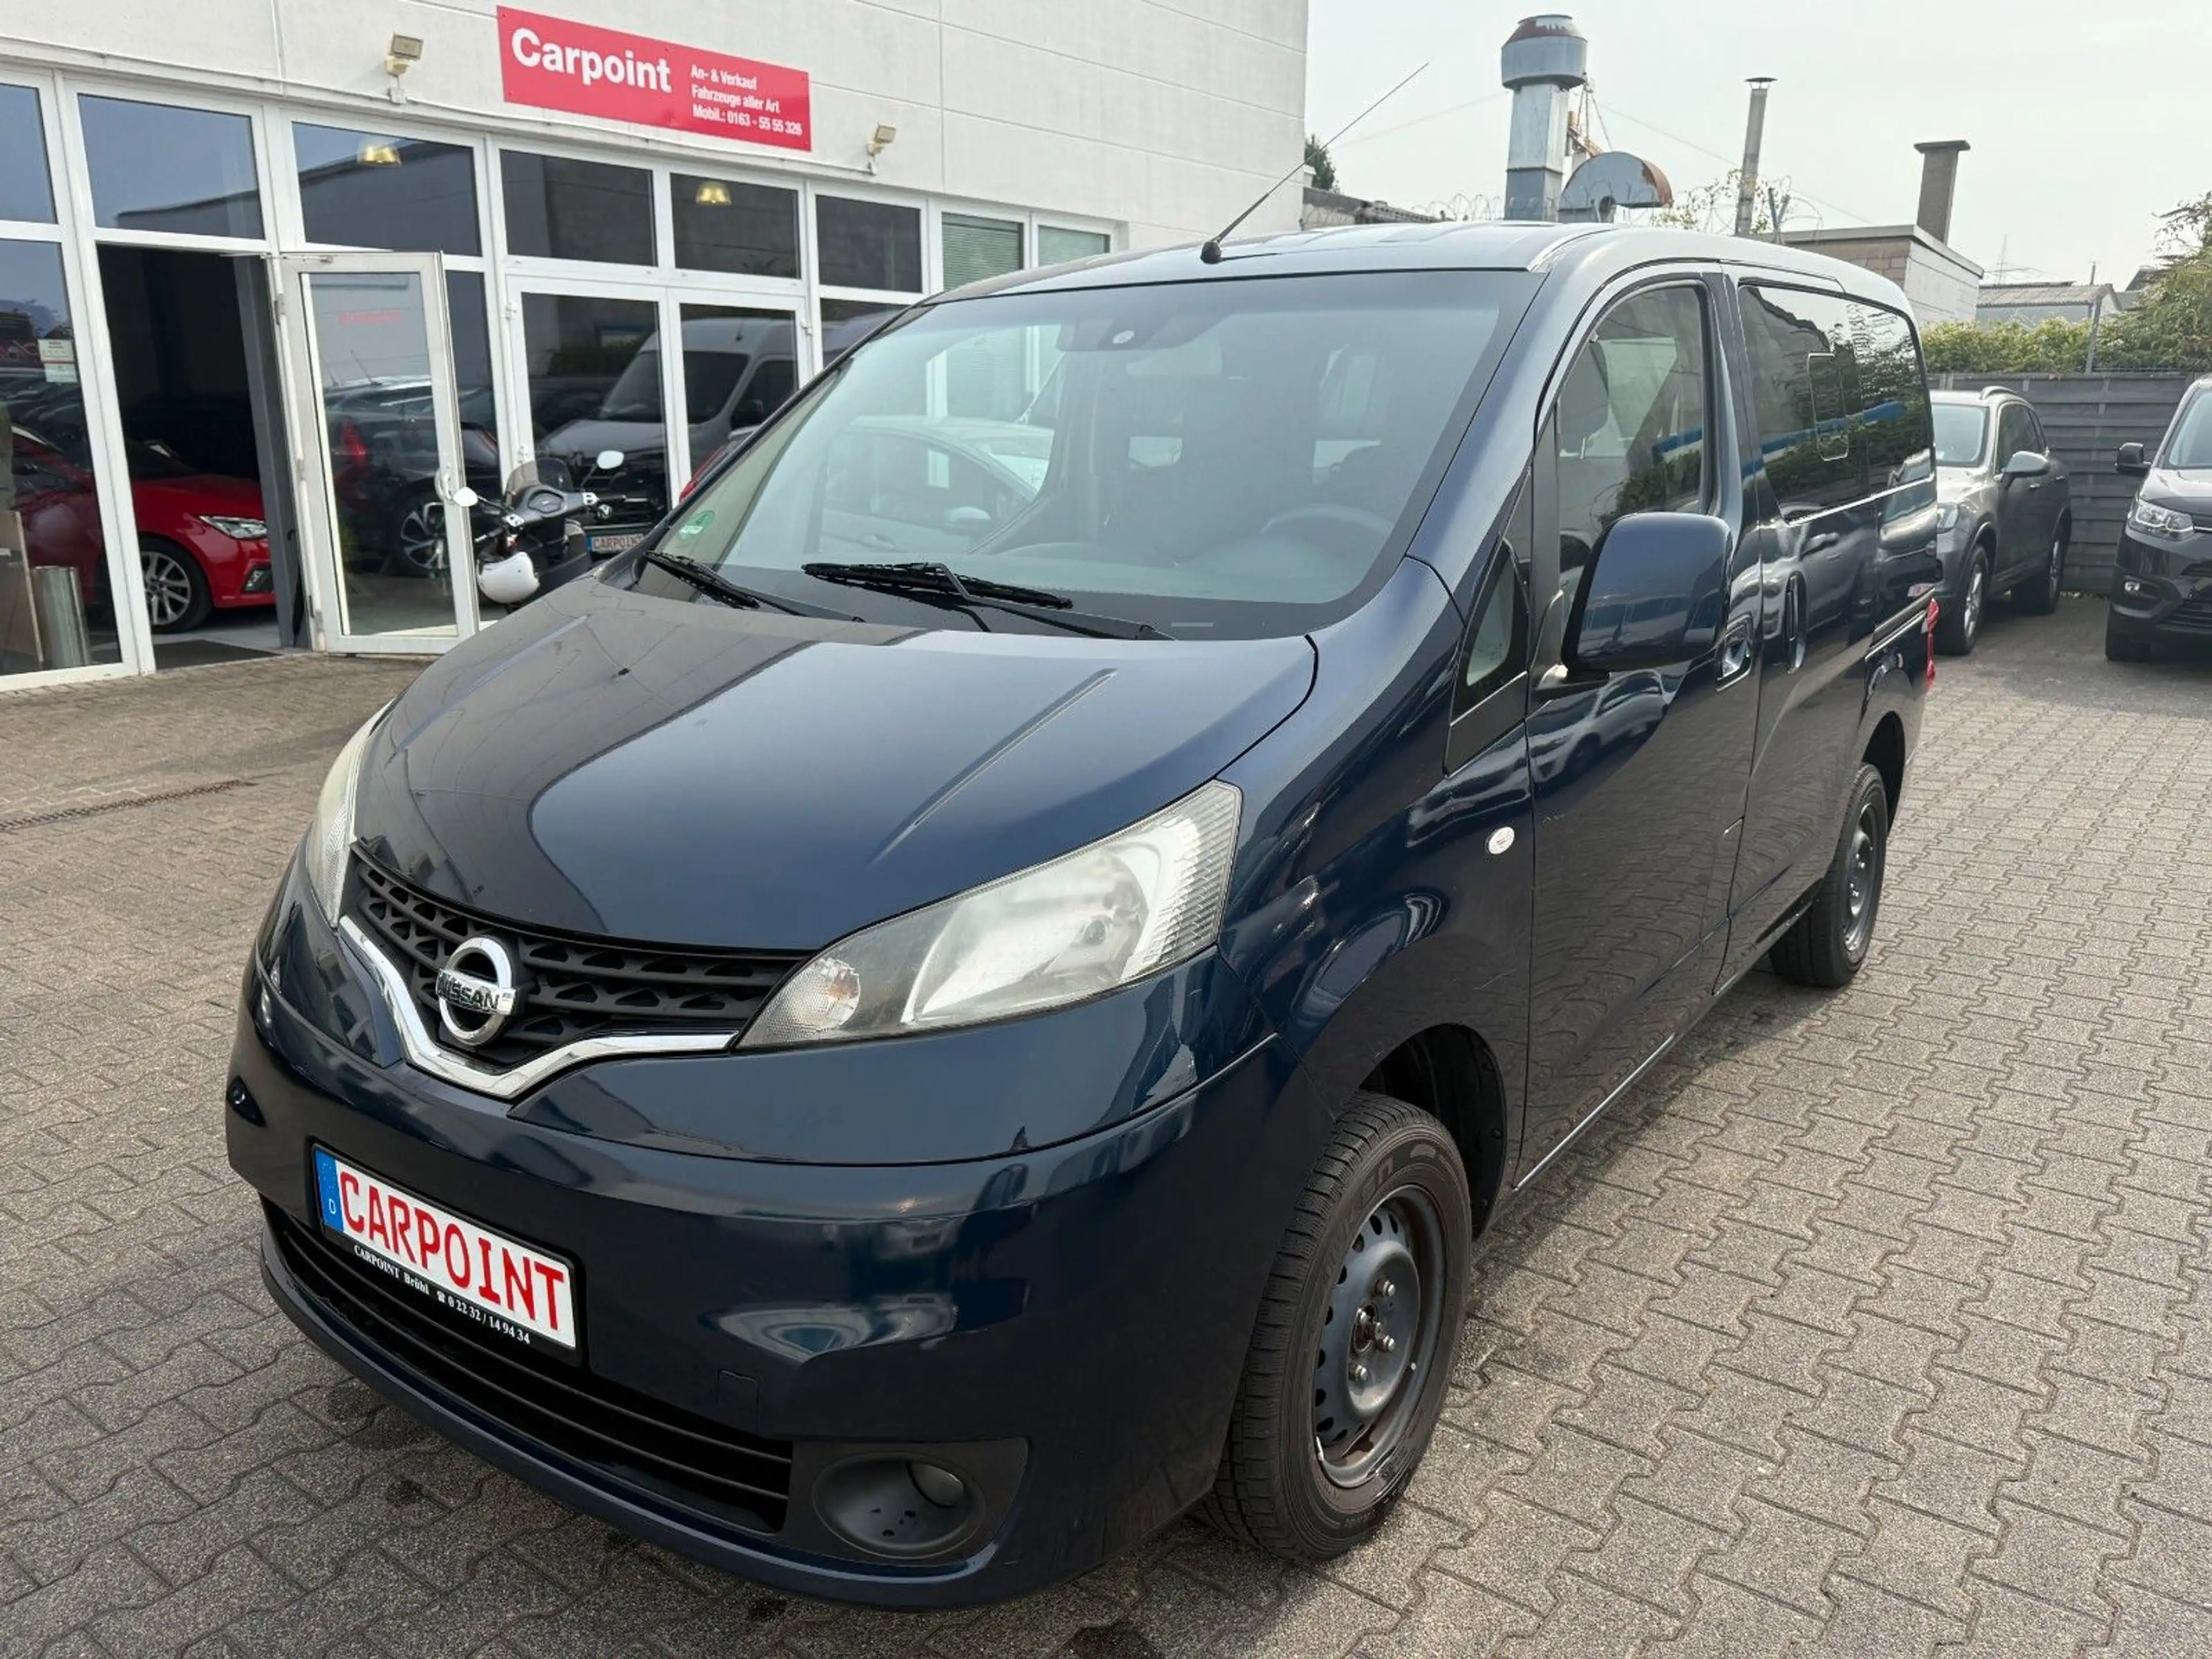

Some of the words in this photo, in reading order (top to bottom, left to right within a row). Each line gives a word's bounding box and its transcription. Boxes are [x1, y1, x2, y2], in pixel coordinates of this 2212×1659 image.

[512, 27, 672, 93] Carpoint
[691, 64, 709, 80] An-
[711, 67, 719, 83] &
[720, 70, 757, 90] Verkauf
[692, 84, 741, 108] Fahrzeuge
[743, 94, 764, 111] aller
[727, 110, 751, 127] 0163
[758, 115, 771, 131] 55
[771, 118, 784, 133] 55
[438, 972, 500, 1010] NISSAN
[329, 1198, 336, 1215] D
[340, 1171, 565, 1331] CARPOINT
[354, 1244, 400, 1278] CARPOINT
[404, 1272, 430, 1295] Brühl
